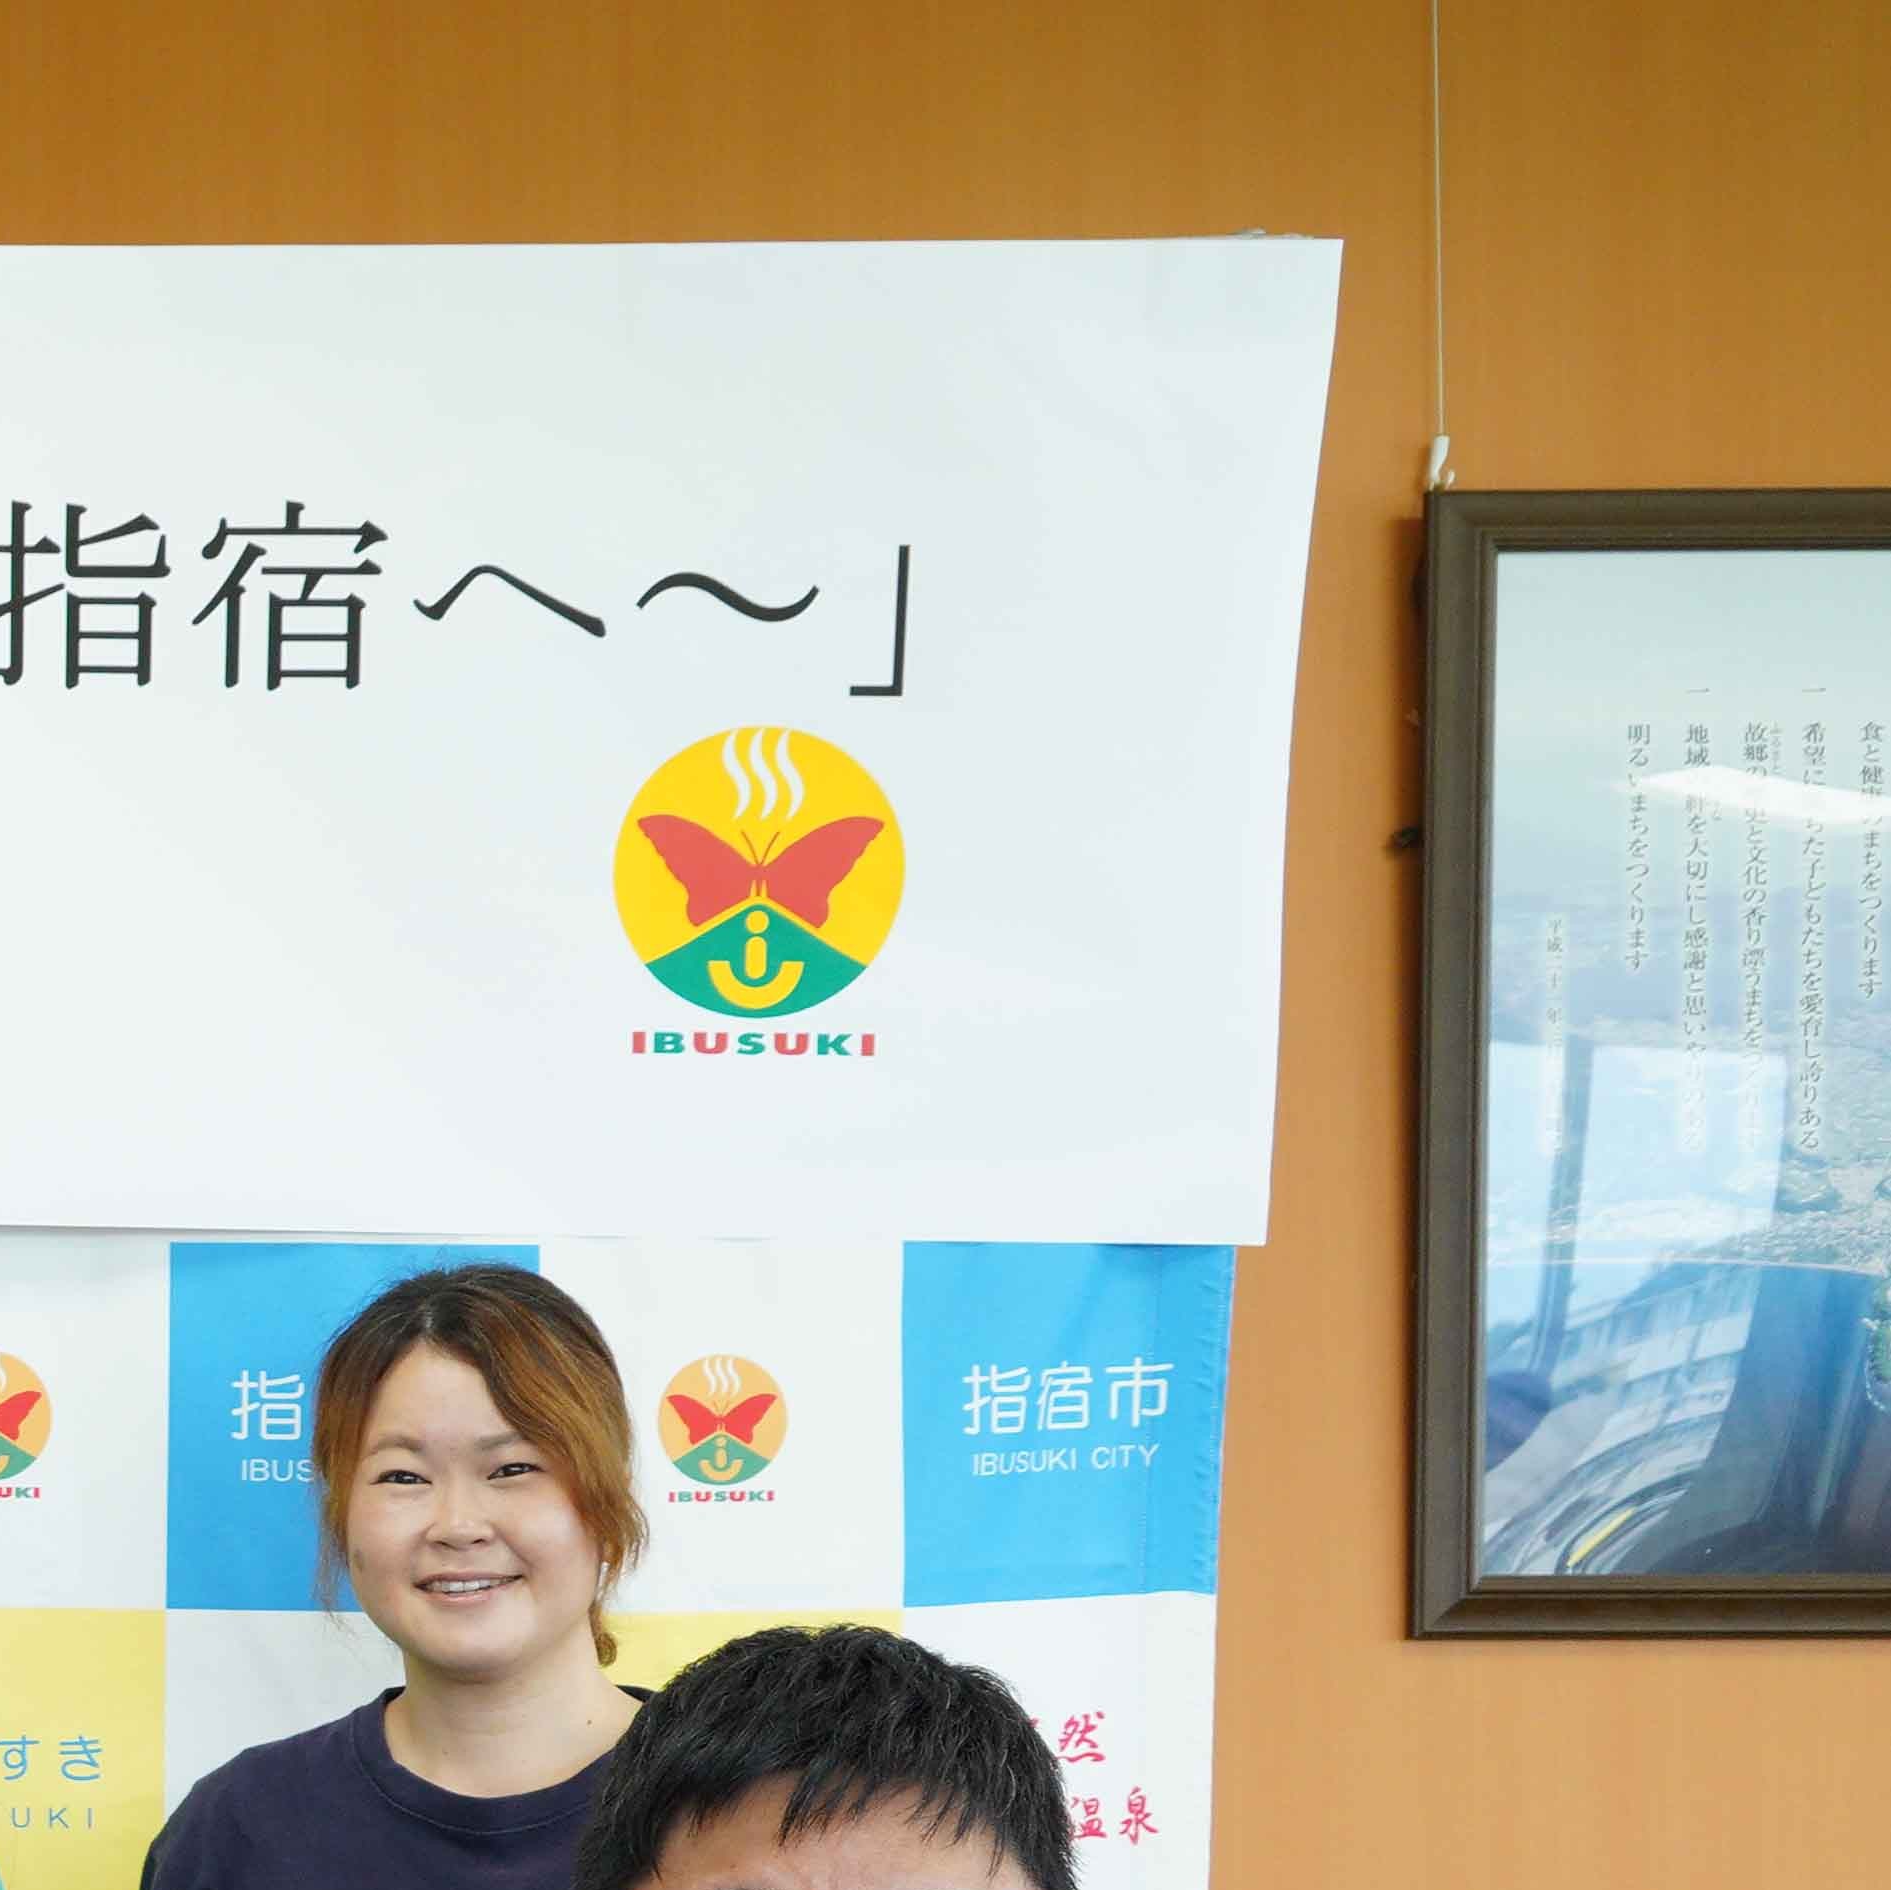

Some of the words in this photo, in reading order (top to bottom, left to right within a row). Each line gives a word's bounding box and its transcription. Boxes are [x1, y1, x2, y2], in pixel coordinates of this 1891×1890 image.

[635, 1033, 875, 1057] IBUSUKI
[965, 1359, 1173, 1435] 指宿市
[975, 1445, 1077, 1478] IBUSUKI
[1092, 1441, 1163, 1470] CITY
[667, 1487, 776, 1503] IBUSUKI
